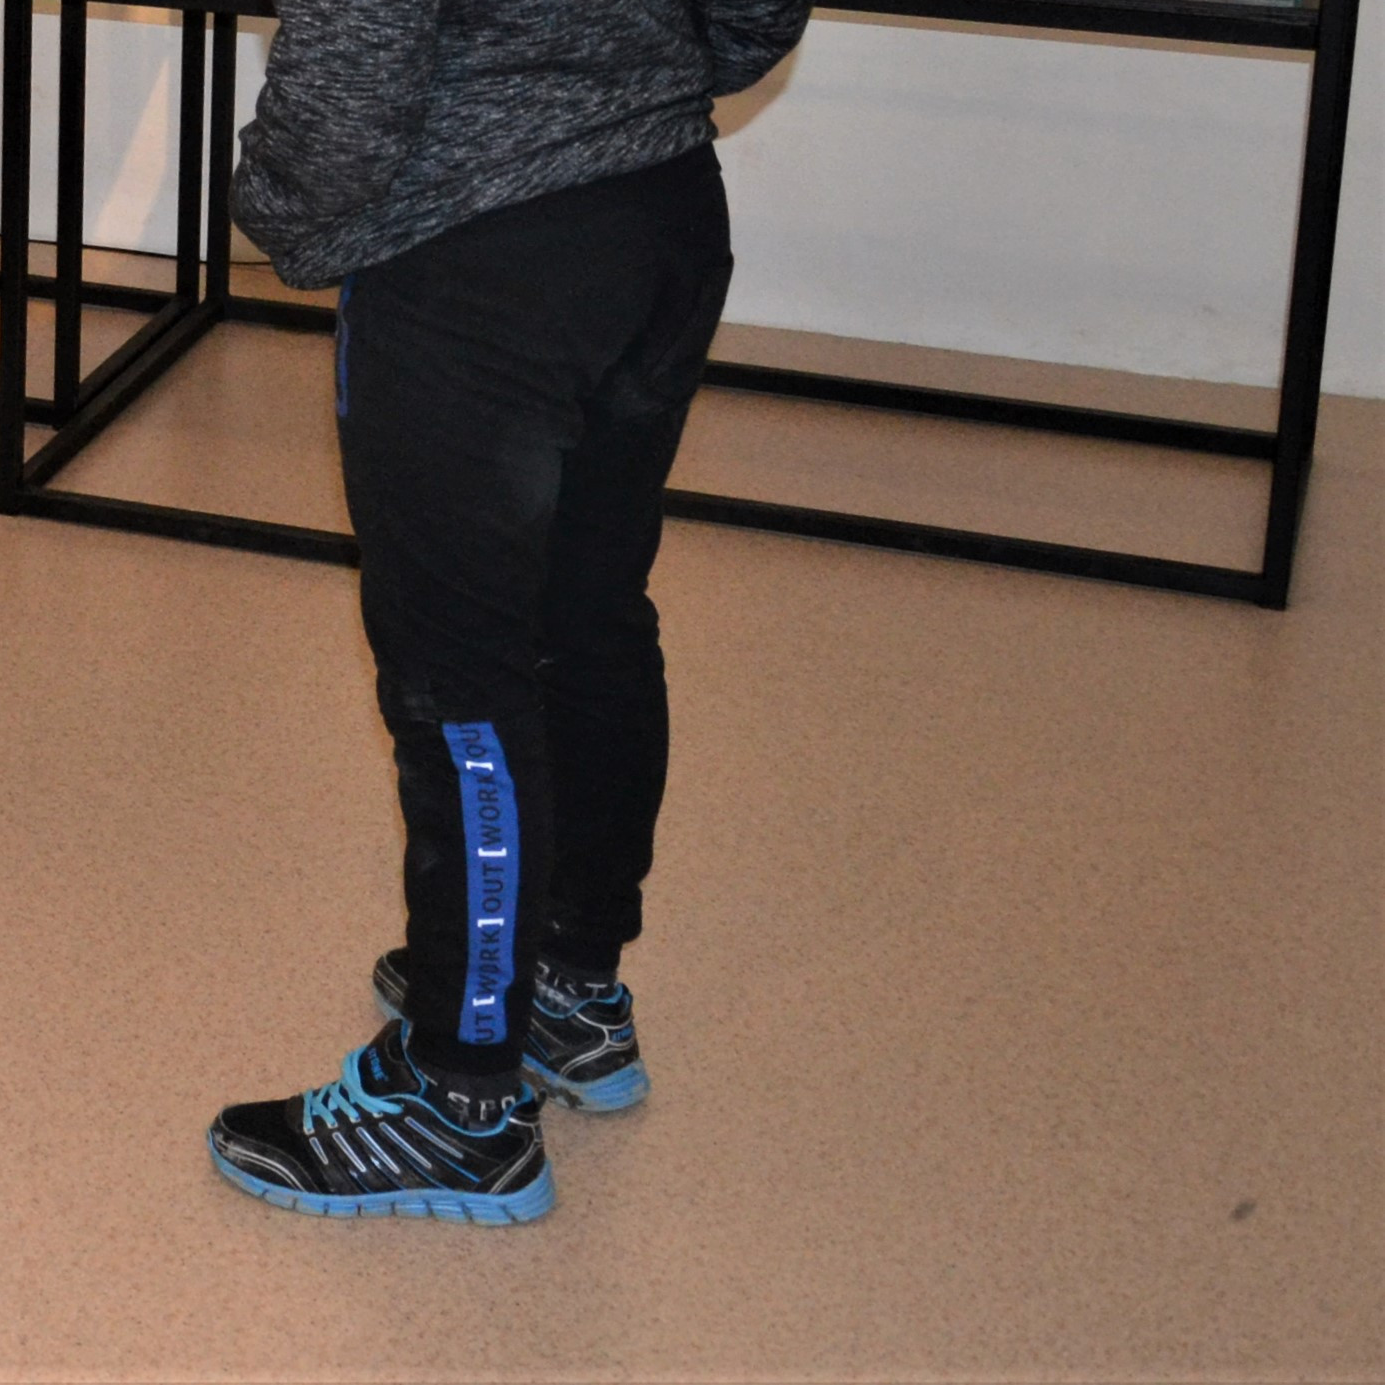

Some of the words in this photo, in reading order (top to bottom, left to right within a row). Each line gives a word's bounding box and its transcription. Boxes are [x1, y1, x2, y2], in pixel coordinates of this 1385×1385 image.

[458, 722, 486, 758] OU
[482, 863, 505, 912] OUT
[473, 1011, 496, 1044] UT
